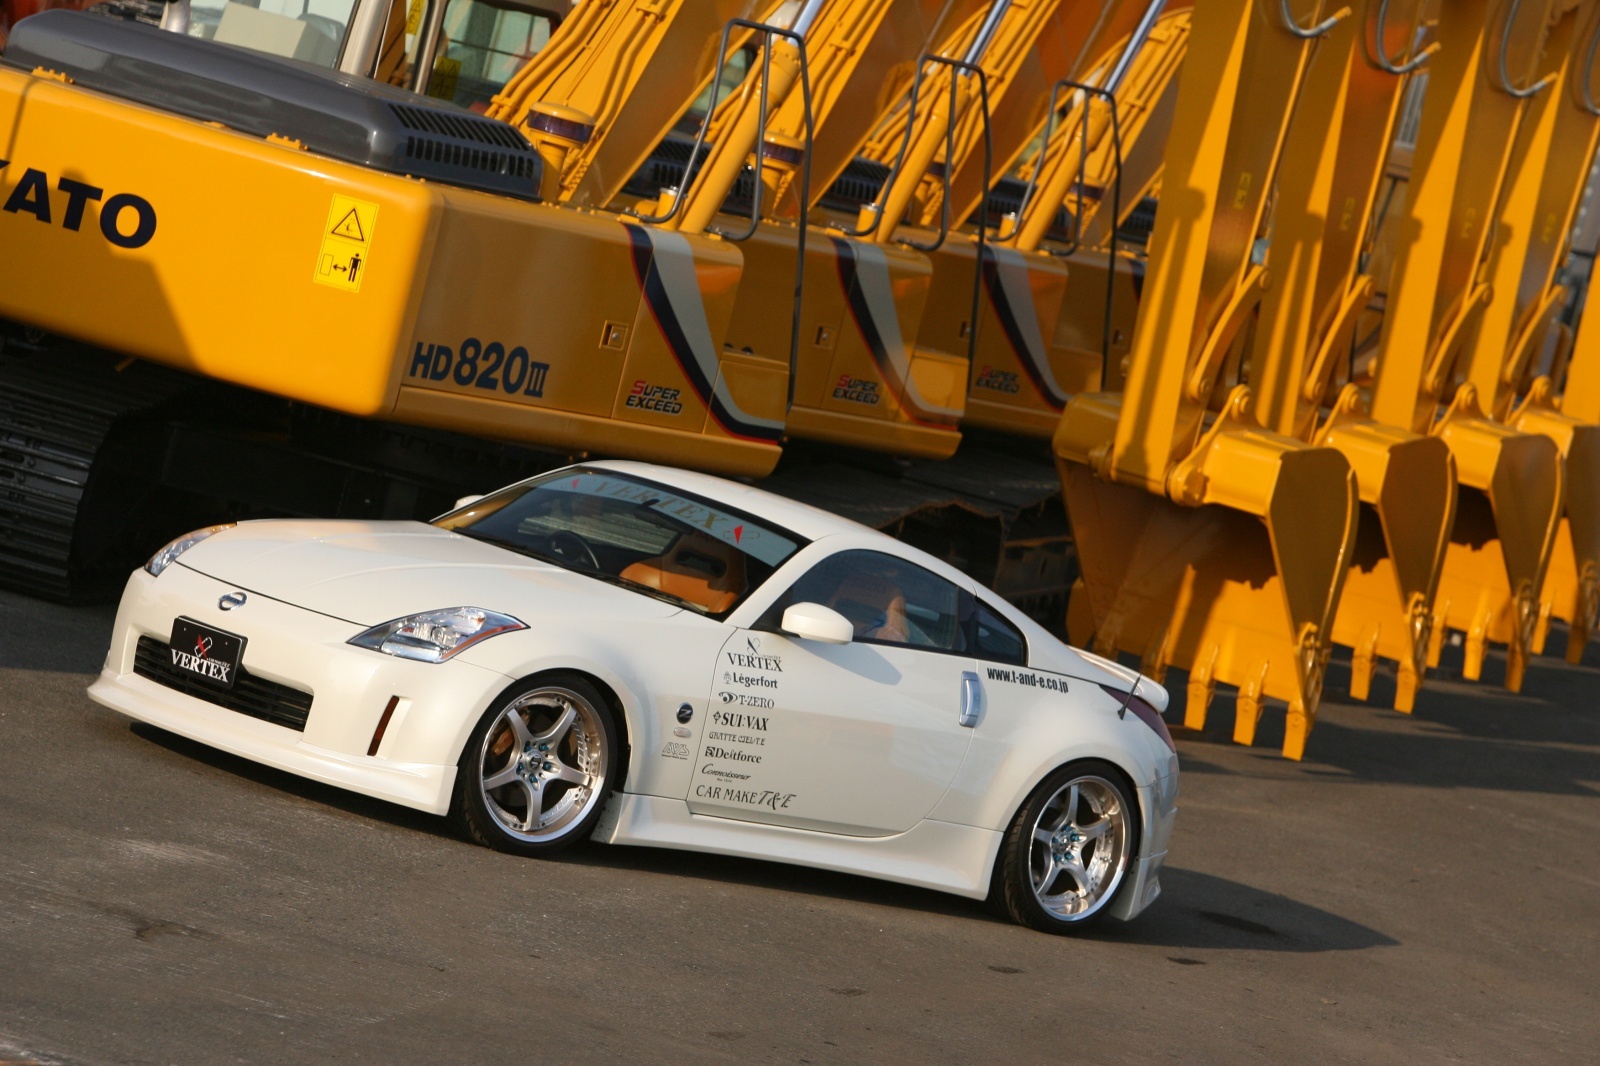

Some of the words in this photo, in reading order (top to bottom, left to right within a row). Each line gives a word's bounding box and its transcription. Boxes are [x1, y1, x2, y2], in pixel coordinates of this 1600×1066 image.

[0, 158, 157, 249] ATO
[837, 374, 879, 393] SUPER
[981, 365, 1019, 382] SUPER
[630, 379, 680, 401] SUPER
[832, 387, 880, 405] EXCEED
[976, 378, 1020, 394] EXCEED
[625, 395, 683, 416] EXCEED
[594, 480, 730, 531] VERTEX
[171, 648, 230, 683] VERTEX
[727, 652, 783, 672] VERTEX
[733, 672, 778, 689] Légerfort
[987, 667, 1069, 693] www.t-and-e.co.jp
[739, 694, 775, 709] T-ZERO
[701, 763, 751, 780] Connoisseur
[696, 784, 721, 800] CAR
[723, 788, 758, 804] MAKE
